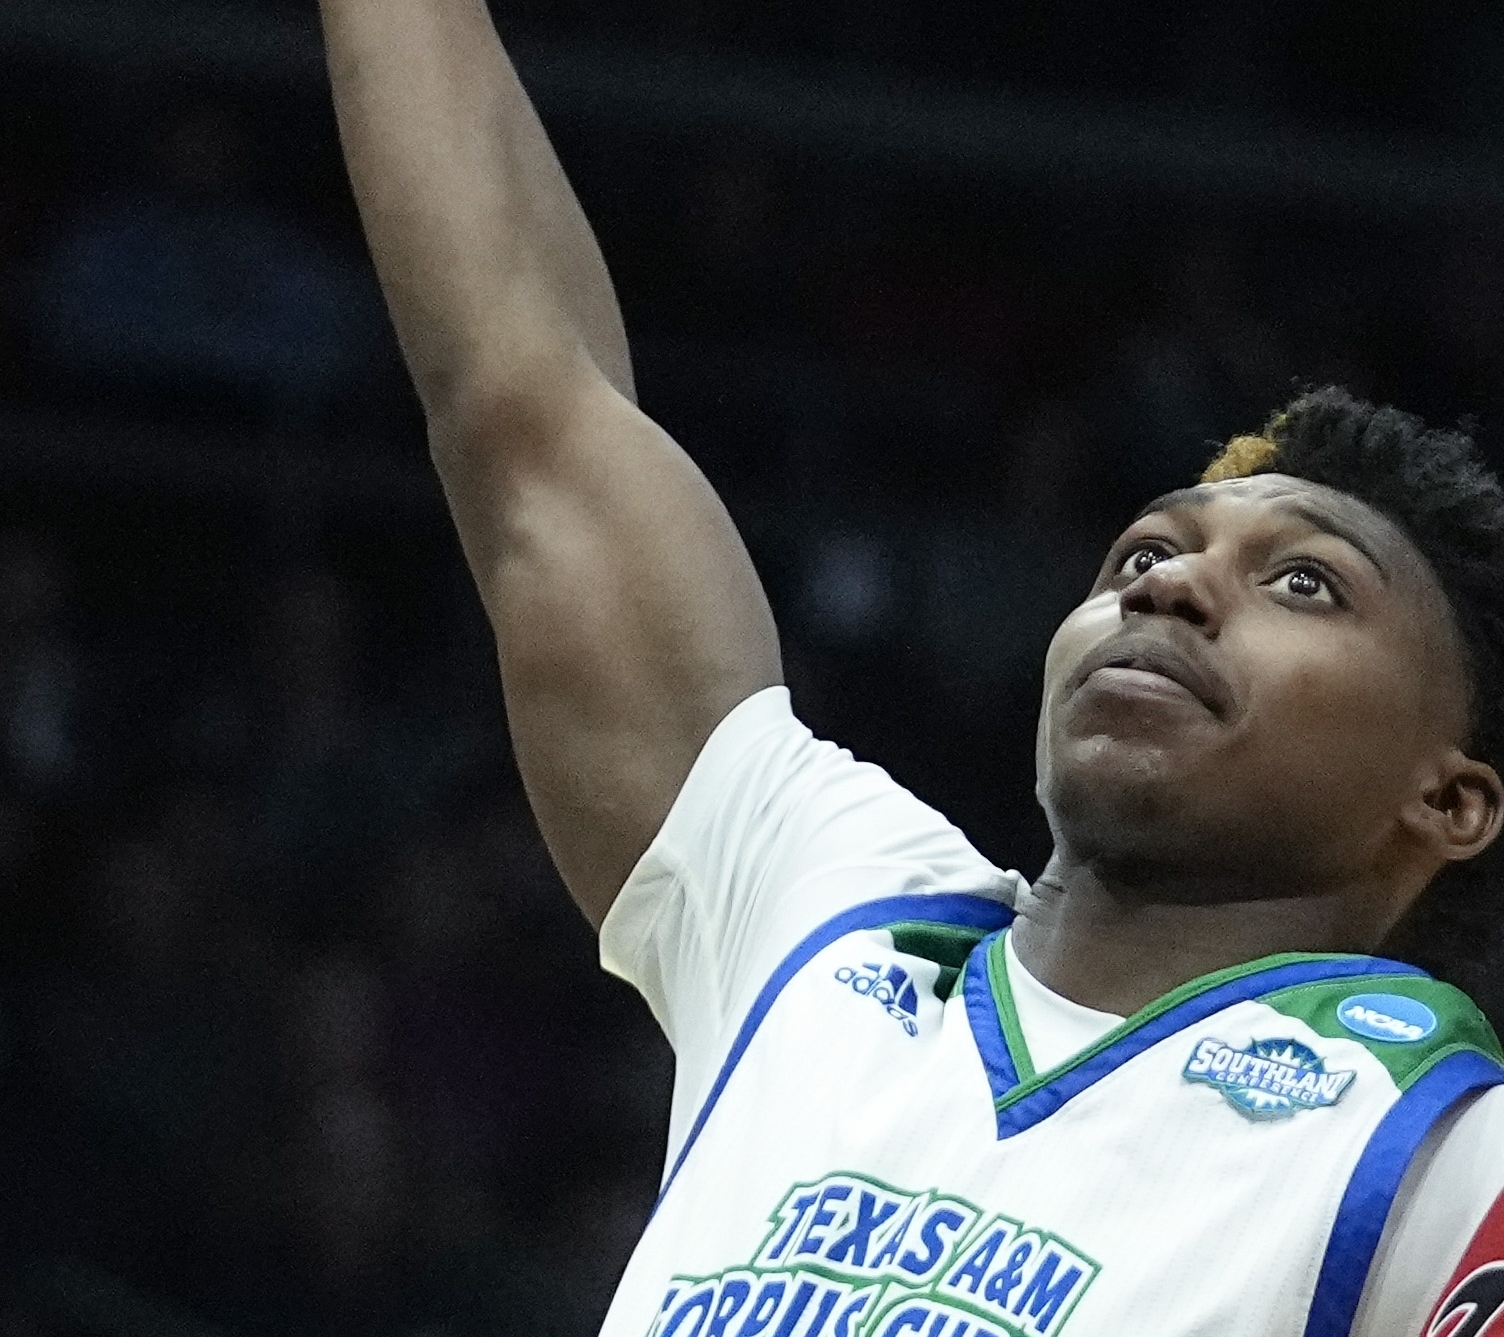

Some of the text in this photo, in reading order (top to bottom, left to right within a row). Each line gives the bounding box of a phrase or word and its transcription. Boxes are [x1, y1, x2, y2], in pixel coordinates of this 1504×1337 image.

[833, 966, 919, 1037] adidas
[1344, 1005, 1424, 1040] NCAA
[1188, 1039, 1353, 1101] SOUTHLAND
[766, 1183, 1085, 1336] TEXAS A&M
